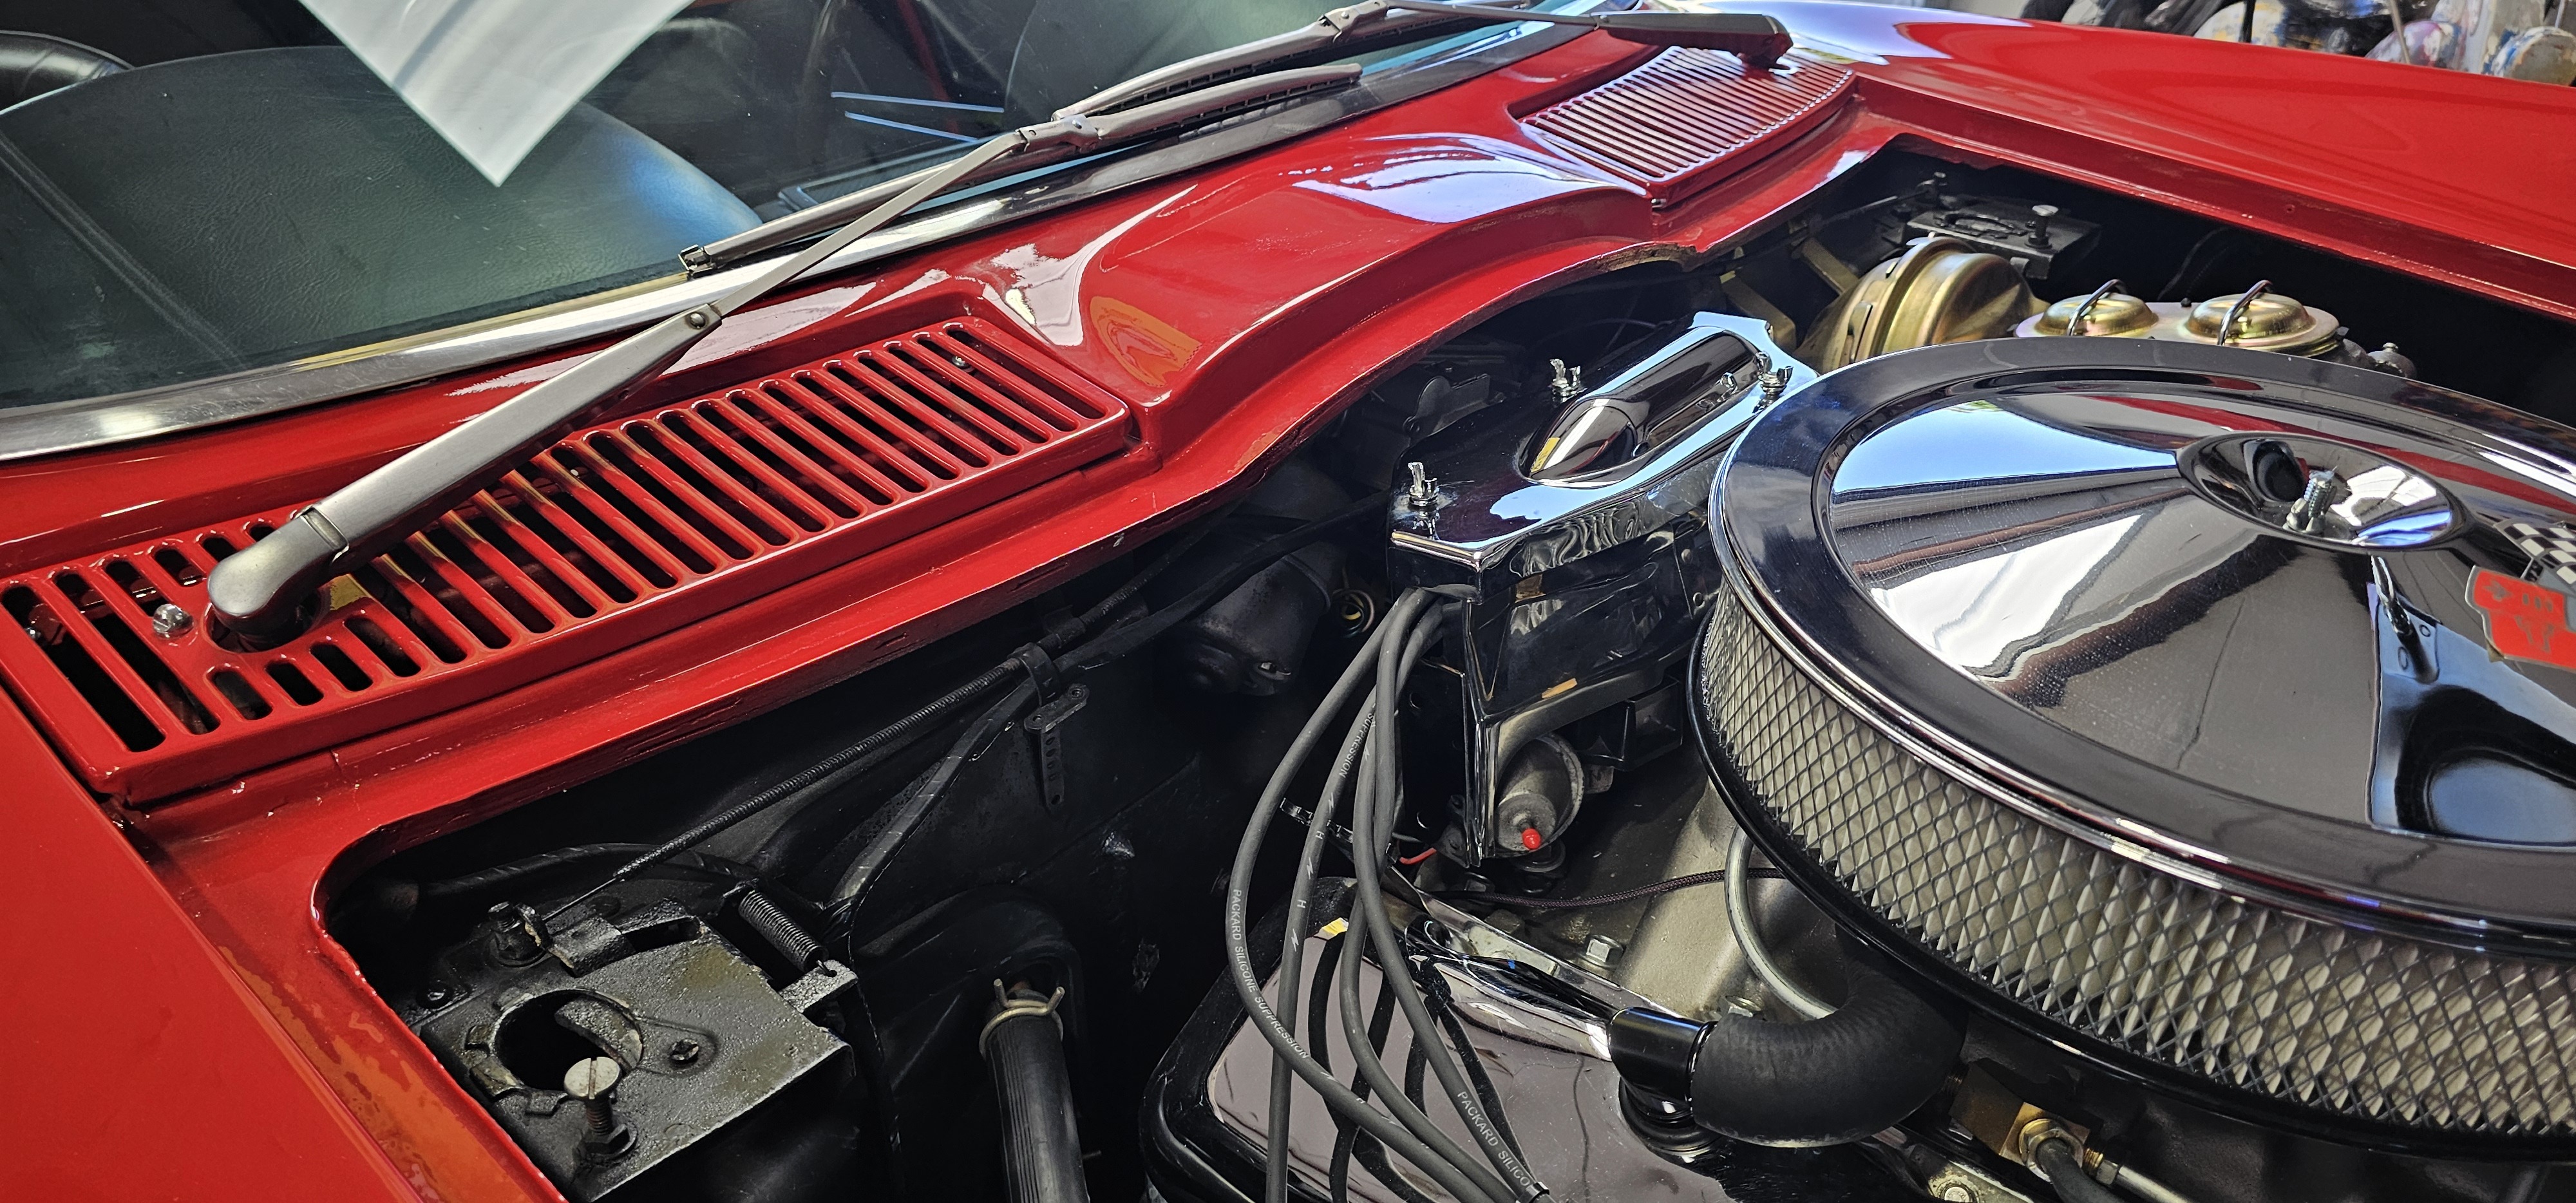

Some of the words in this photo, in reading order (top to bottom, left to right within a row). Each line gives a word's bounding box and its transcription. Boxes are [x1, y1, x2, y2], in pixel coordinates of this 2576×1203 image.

[1231, 889, 1242, 940] PACKARD
[1235, 946, 1257, 992] SILICONE
[1255, 996, 1310, 1059] SUPPRESSION
[1457, 1091, 1499, 1146] PACKARD
[1498, 1150, 1531, 1187] SILICO
